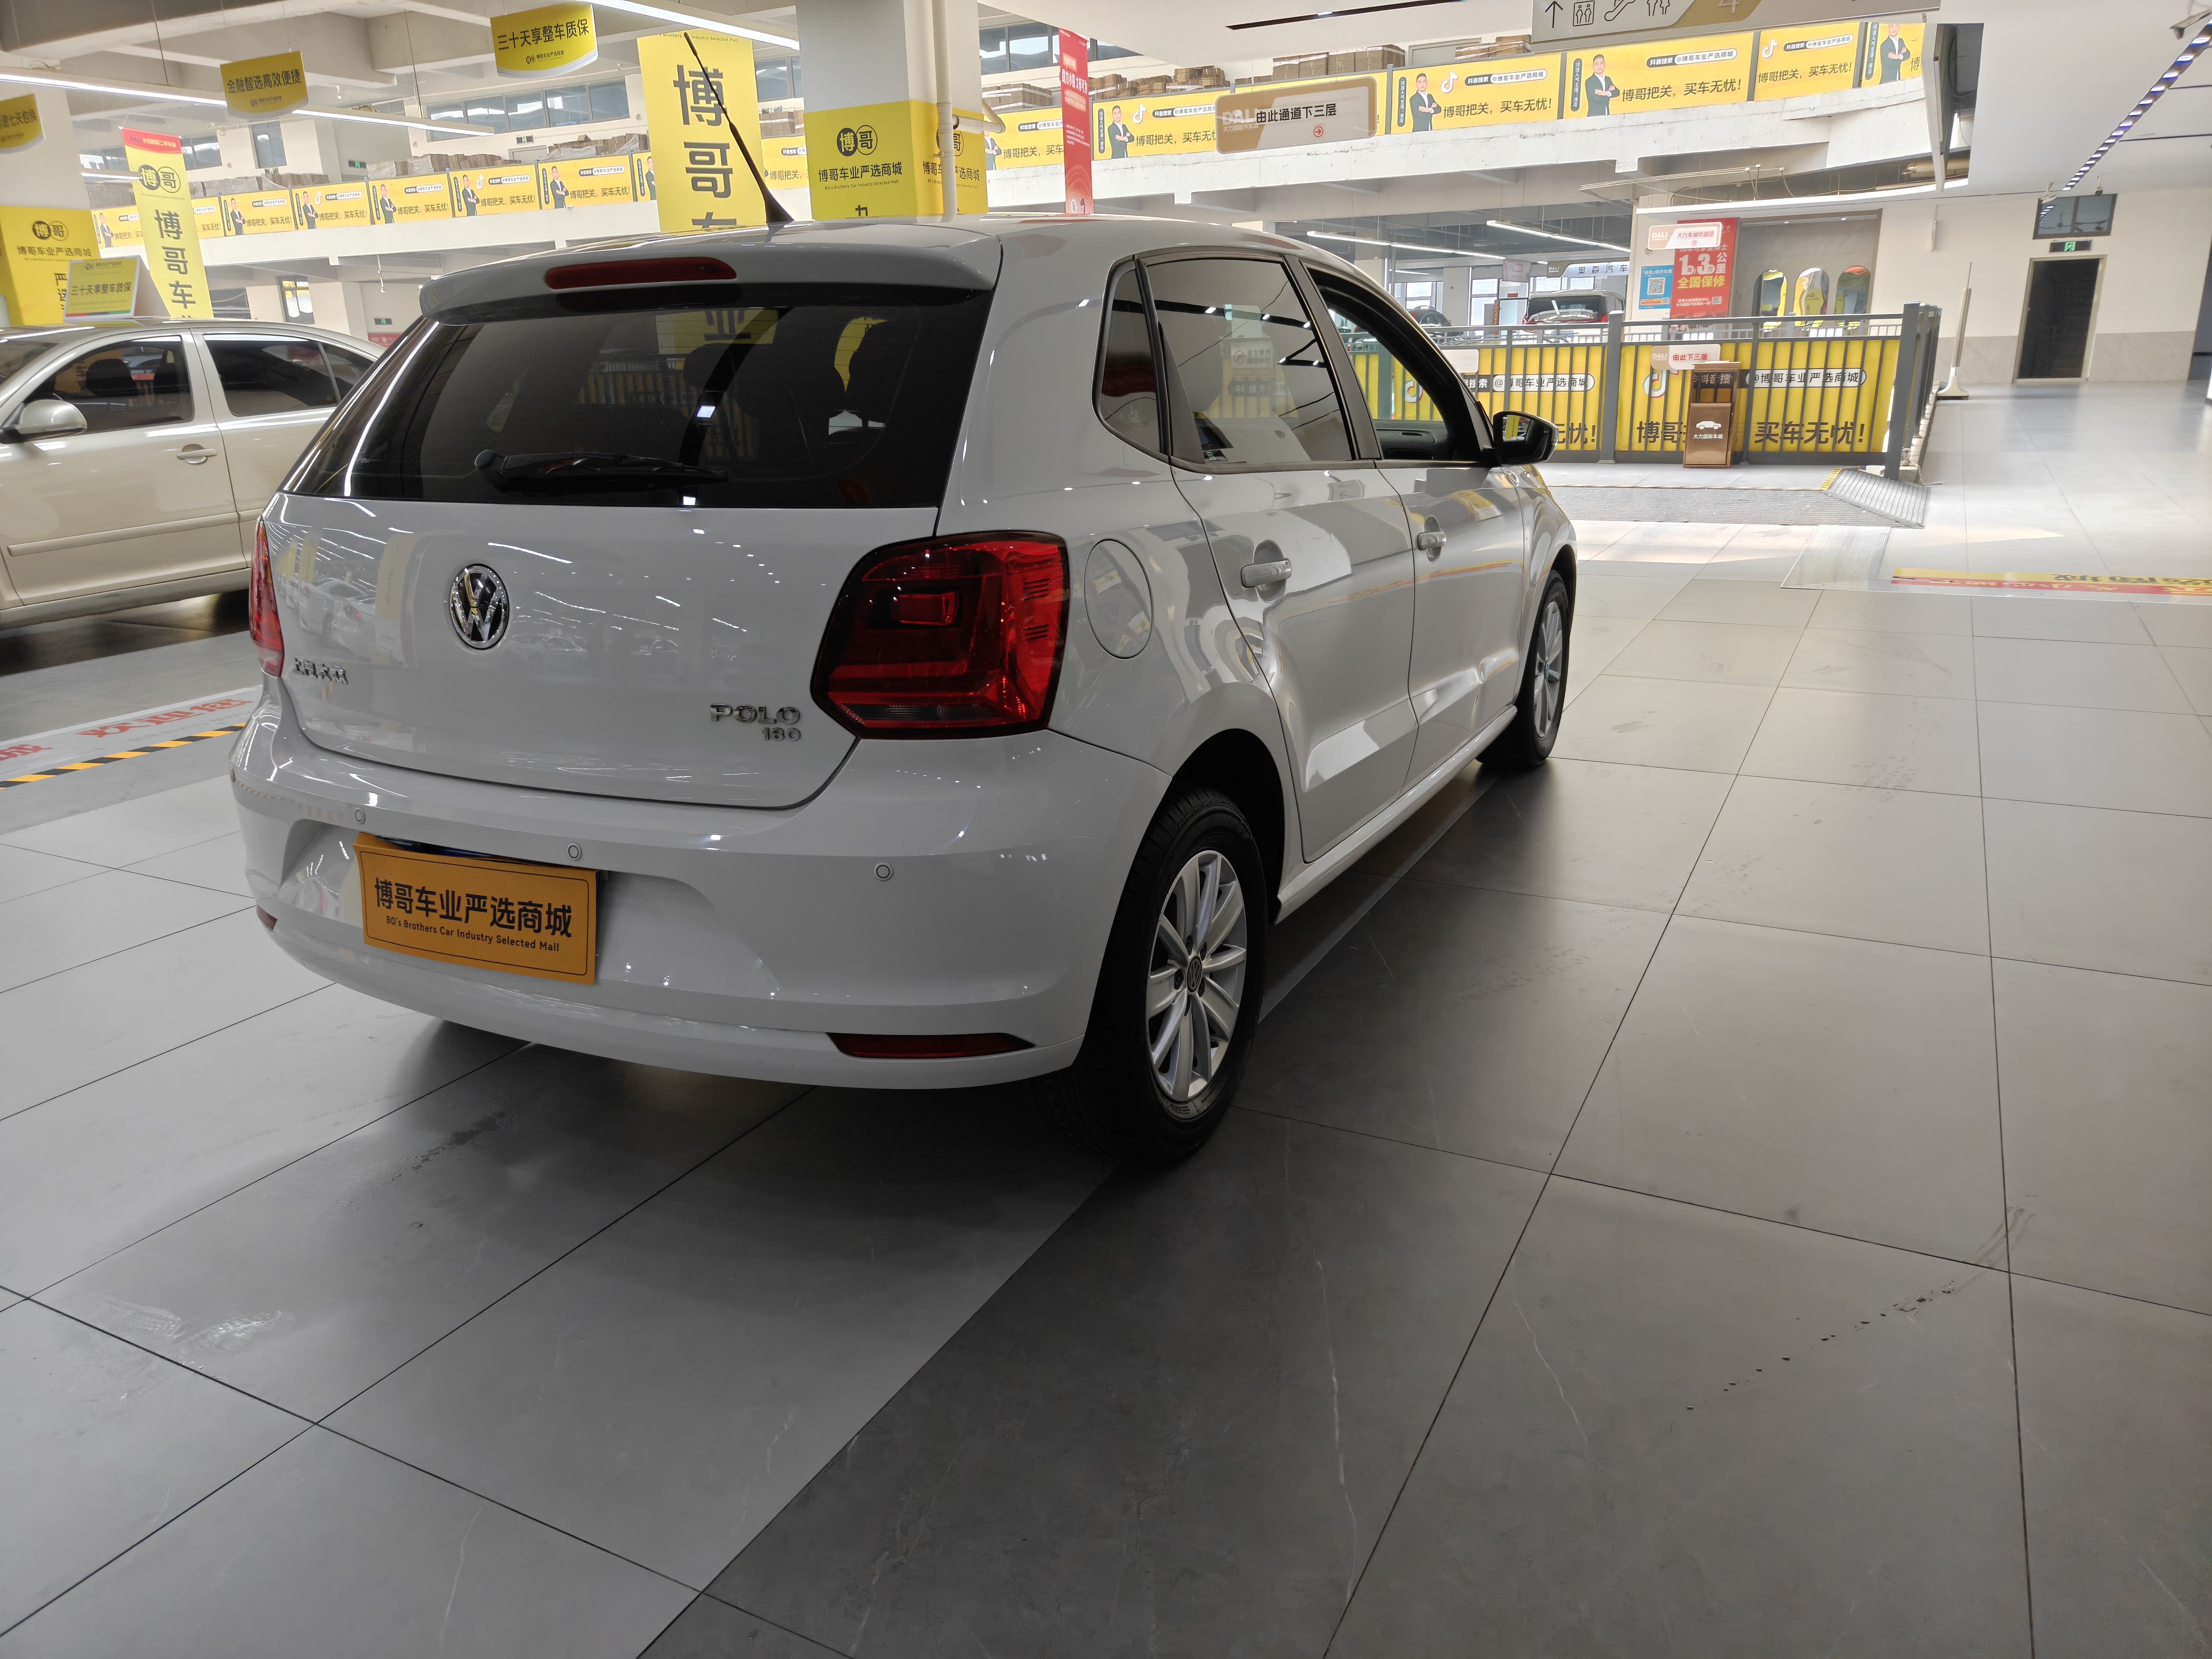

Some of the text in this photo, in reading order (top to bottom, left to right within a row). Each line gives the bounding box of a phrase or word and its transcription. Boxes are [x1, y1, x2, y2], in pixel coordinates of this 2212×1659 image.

[498, 19, 589, 50] 三十天享整车质保
[1676, 51, 1733, 63] @博哥车业严选商城
[227, 69, 302, 93] 金融智选高效便捷
[1492, 71, 1544, 83] @博哥车业严选商城
[1758, 62, 1852, 83] 博哥把关，买车无忧！
[1622, 79, 1742, 102] 博哥把关，买车无忧！
[1256, 103, 1337, 123] 由此通道下三层
[1443, 98, 1552, 118] 博哥把关，买车无忧！
[839, 131, 873, 153] 博哥
[141, 168, 176, 189] 博哥
[818, 162, 903, 183] 博哥车业严选商城
[154, 209, 196, 318] 博哥车
[1677, 275, 1725, 289] 全国保修
[1637, 421, 1687, 443] 博哥
[710, 703, 801, 725] POLO
[762, 727, 801, 742] 180
[375, 877, 572, 938] 博哥车业严选商城
[386, 915, 559, 952] BO's Brothers Car Industry Selected Mall
